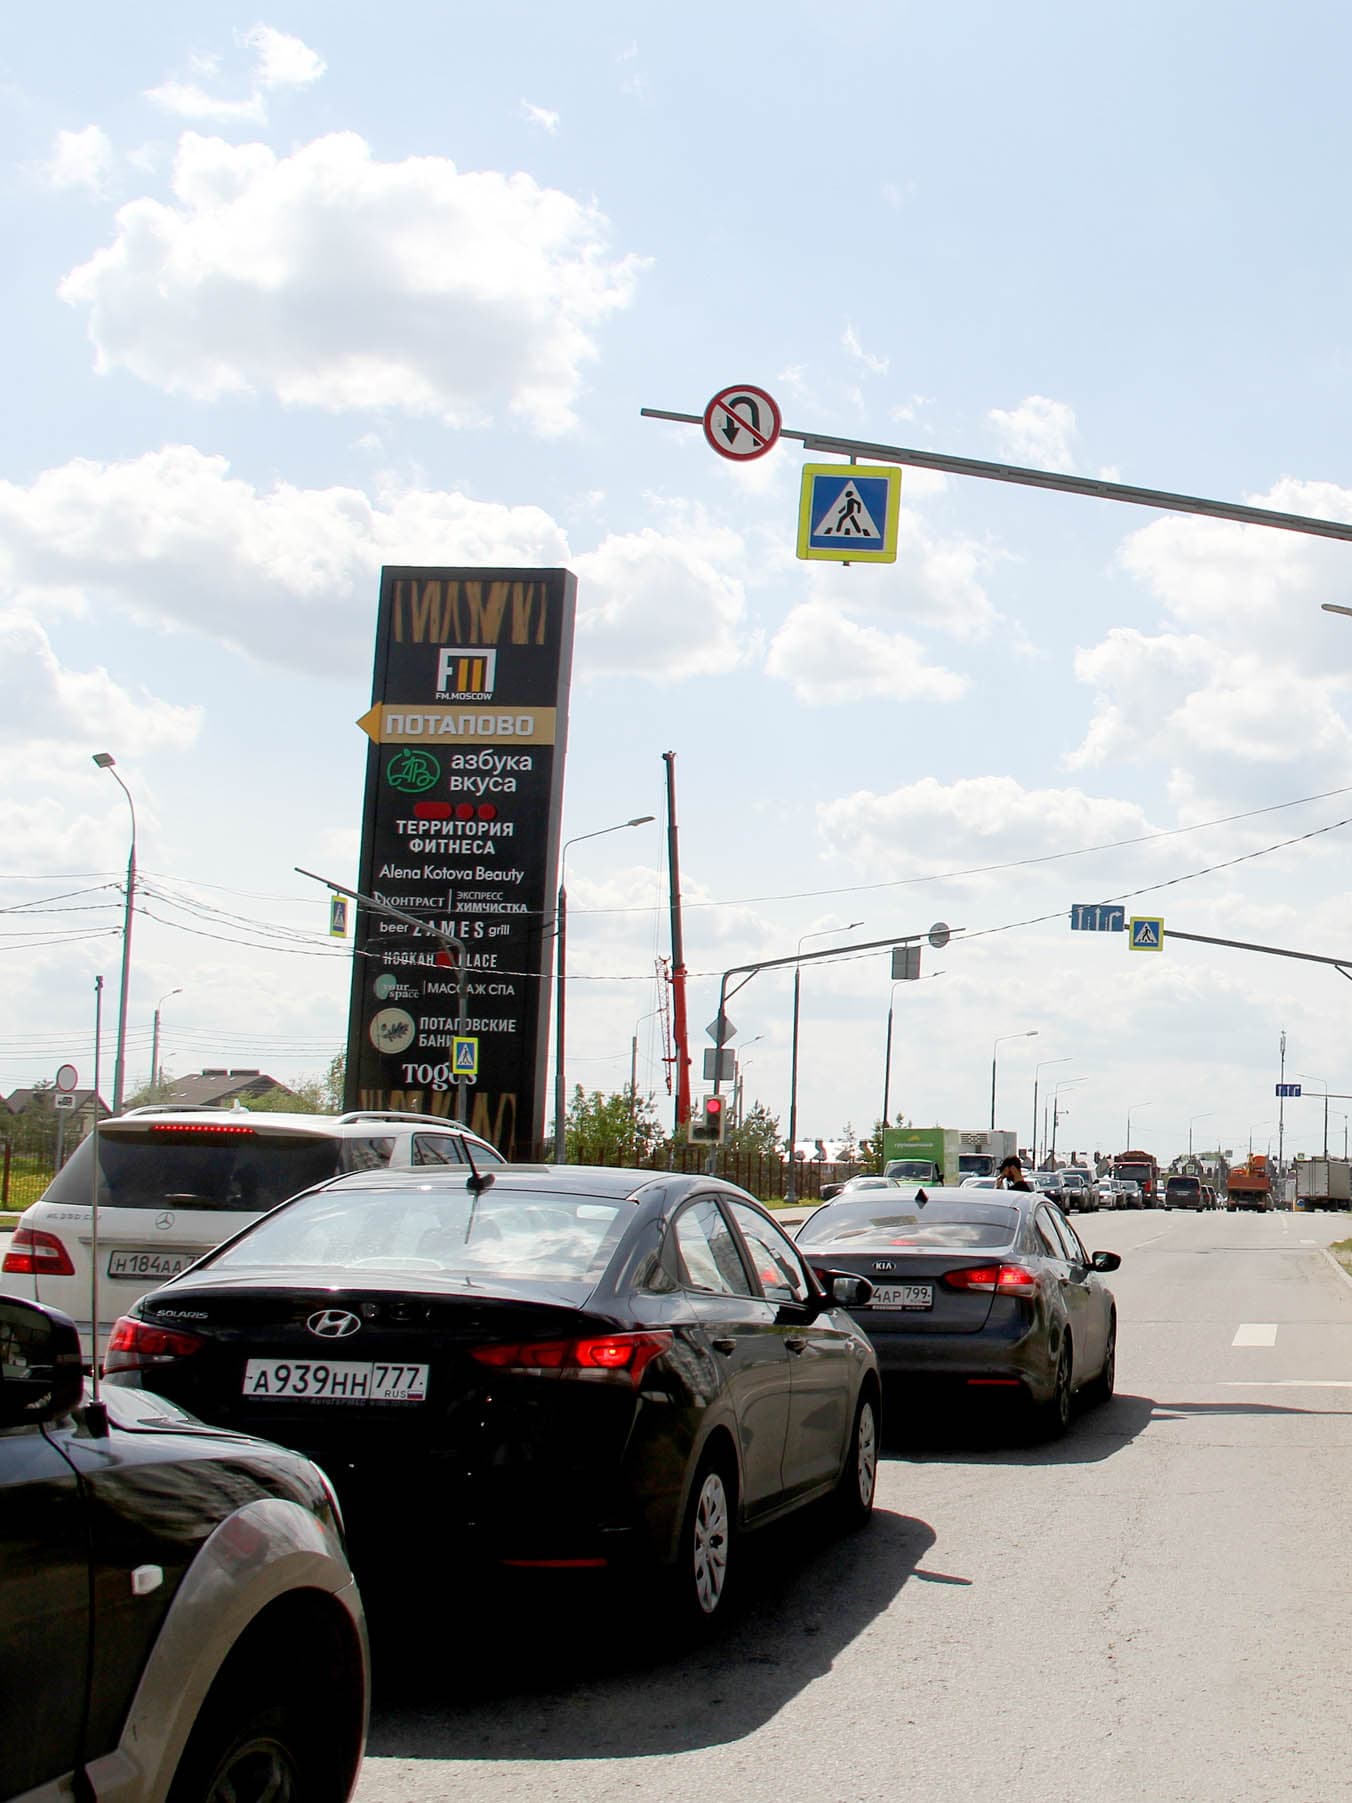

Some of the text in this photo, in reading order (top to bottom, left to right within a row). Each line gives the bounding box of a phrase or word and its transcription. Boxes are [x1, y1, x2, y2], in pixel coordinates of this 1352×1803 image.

[385, 714, 535, 737] ПОТАПОВО
[451, 749, 532, 774] азбука
[450, 776, 516, 796] вкуса
[396, 820, 514, 836] ТЕРРИТОРИЯ
[409, 838, 495, 854] ФИТНЕСА
[379, 864, 525, 885] Alena Kotova Beauty
[457, 891, 504, 901] ЭКСПРЕСС
[455, 901, 529, 913] ХИМЧИСТКА
[380, 921, 408, 932] beer
[488, 924, 510, 937] grill
[384, 951, 434, 966] HOOKAH
[488, 984, 515, 995] СПА
[875, 1262, 892, 1270] KIA
[156, 1309, 208, 1319] SOLARIS
[384, 1389, 406, 1398] RUS
